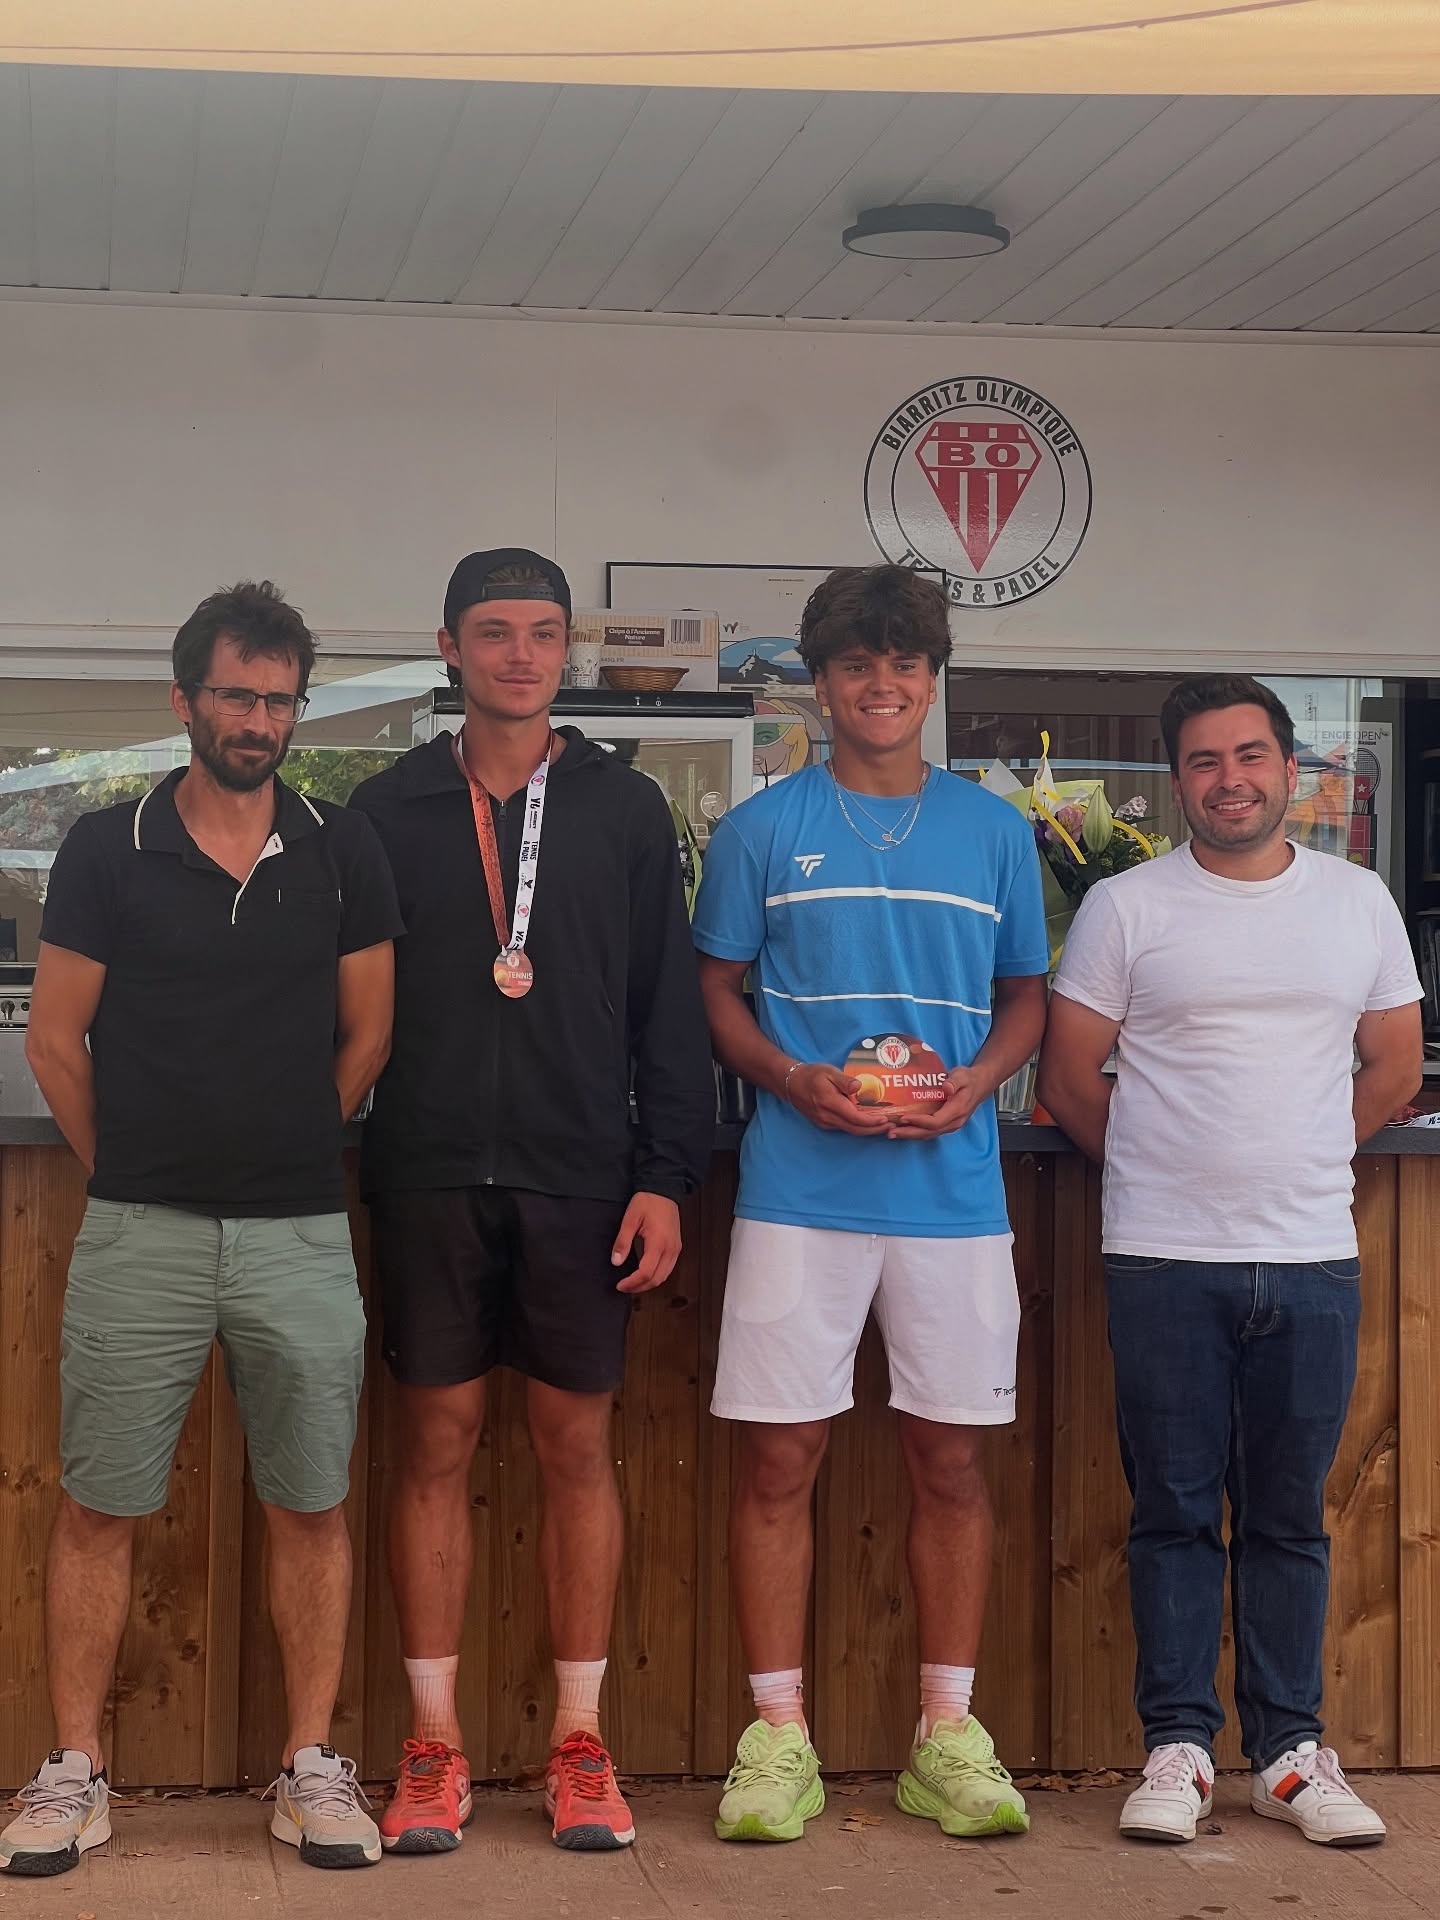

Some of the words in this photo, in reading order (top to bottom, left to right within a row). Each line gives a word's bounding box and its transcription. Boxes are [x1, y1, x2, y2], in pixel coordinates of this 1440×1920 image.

[881, 382, 968, 451] BIARRITZ
[976, 381, 1078, 457] OLYMPIQUE
[937, 442, 1021, 468] BO
[972, 583, 985, 603] &
[993, 554, 1060, 602] PADEL
[508, 971, 533, 980] TENNIS
[881, 1073, 946, 1088] TENNIS
